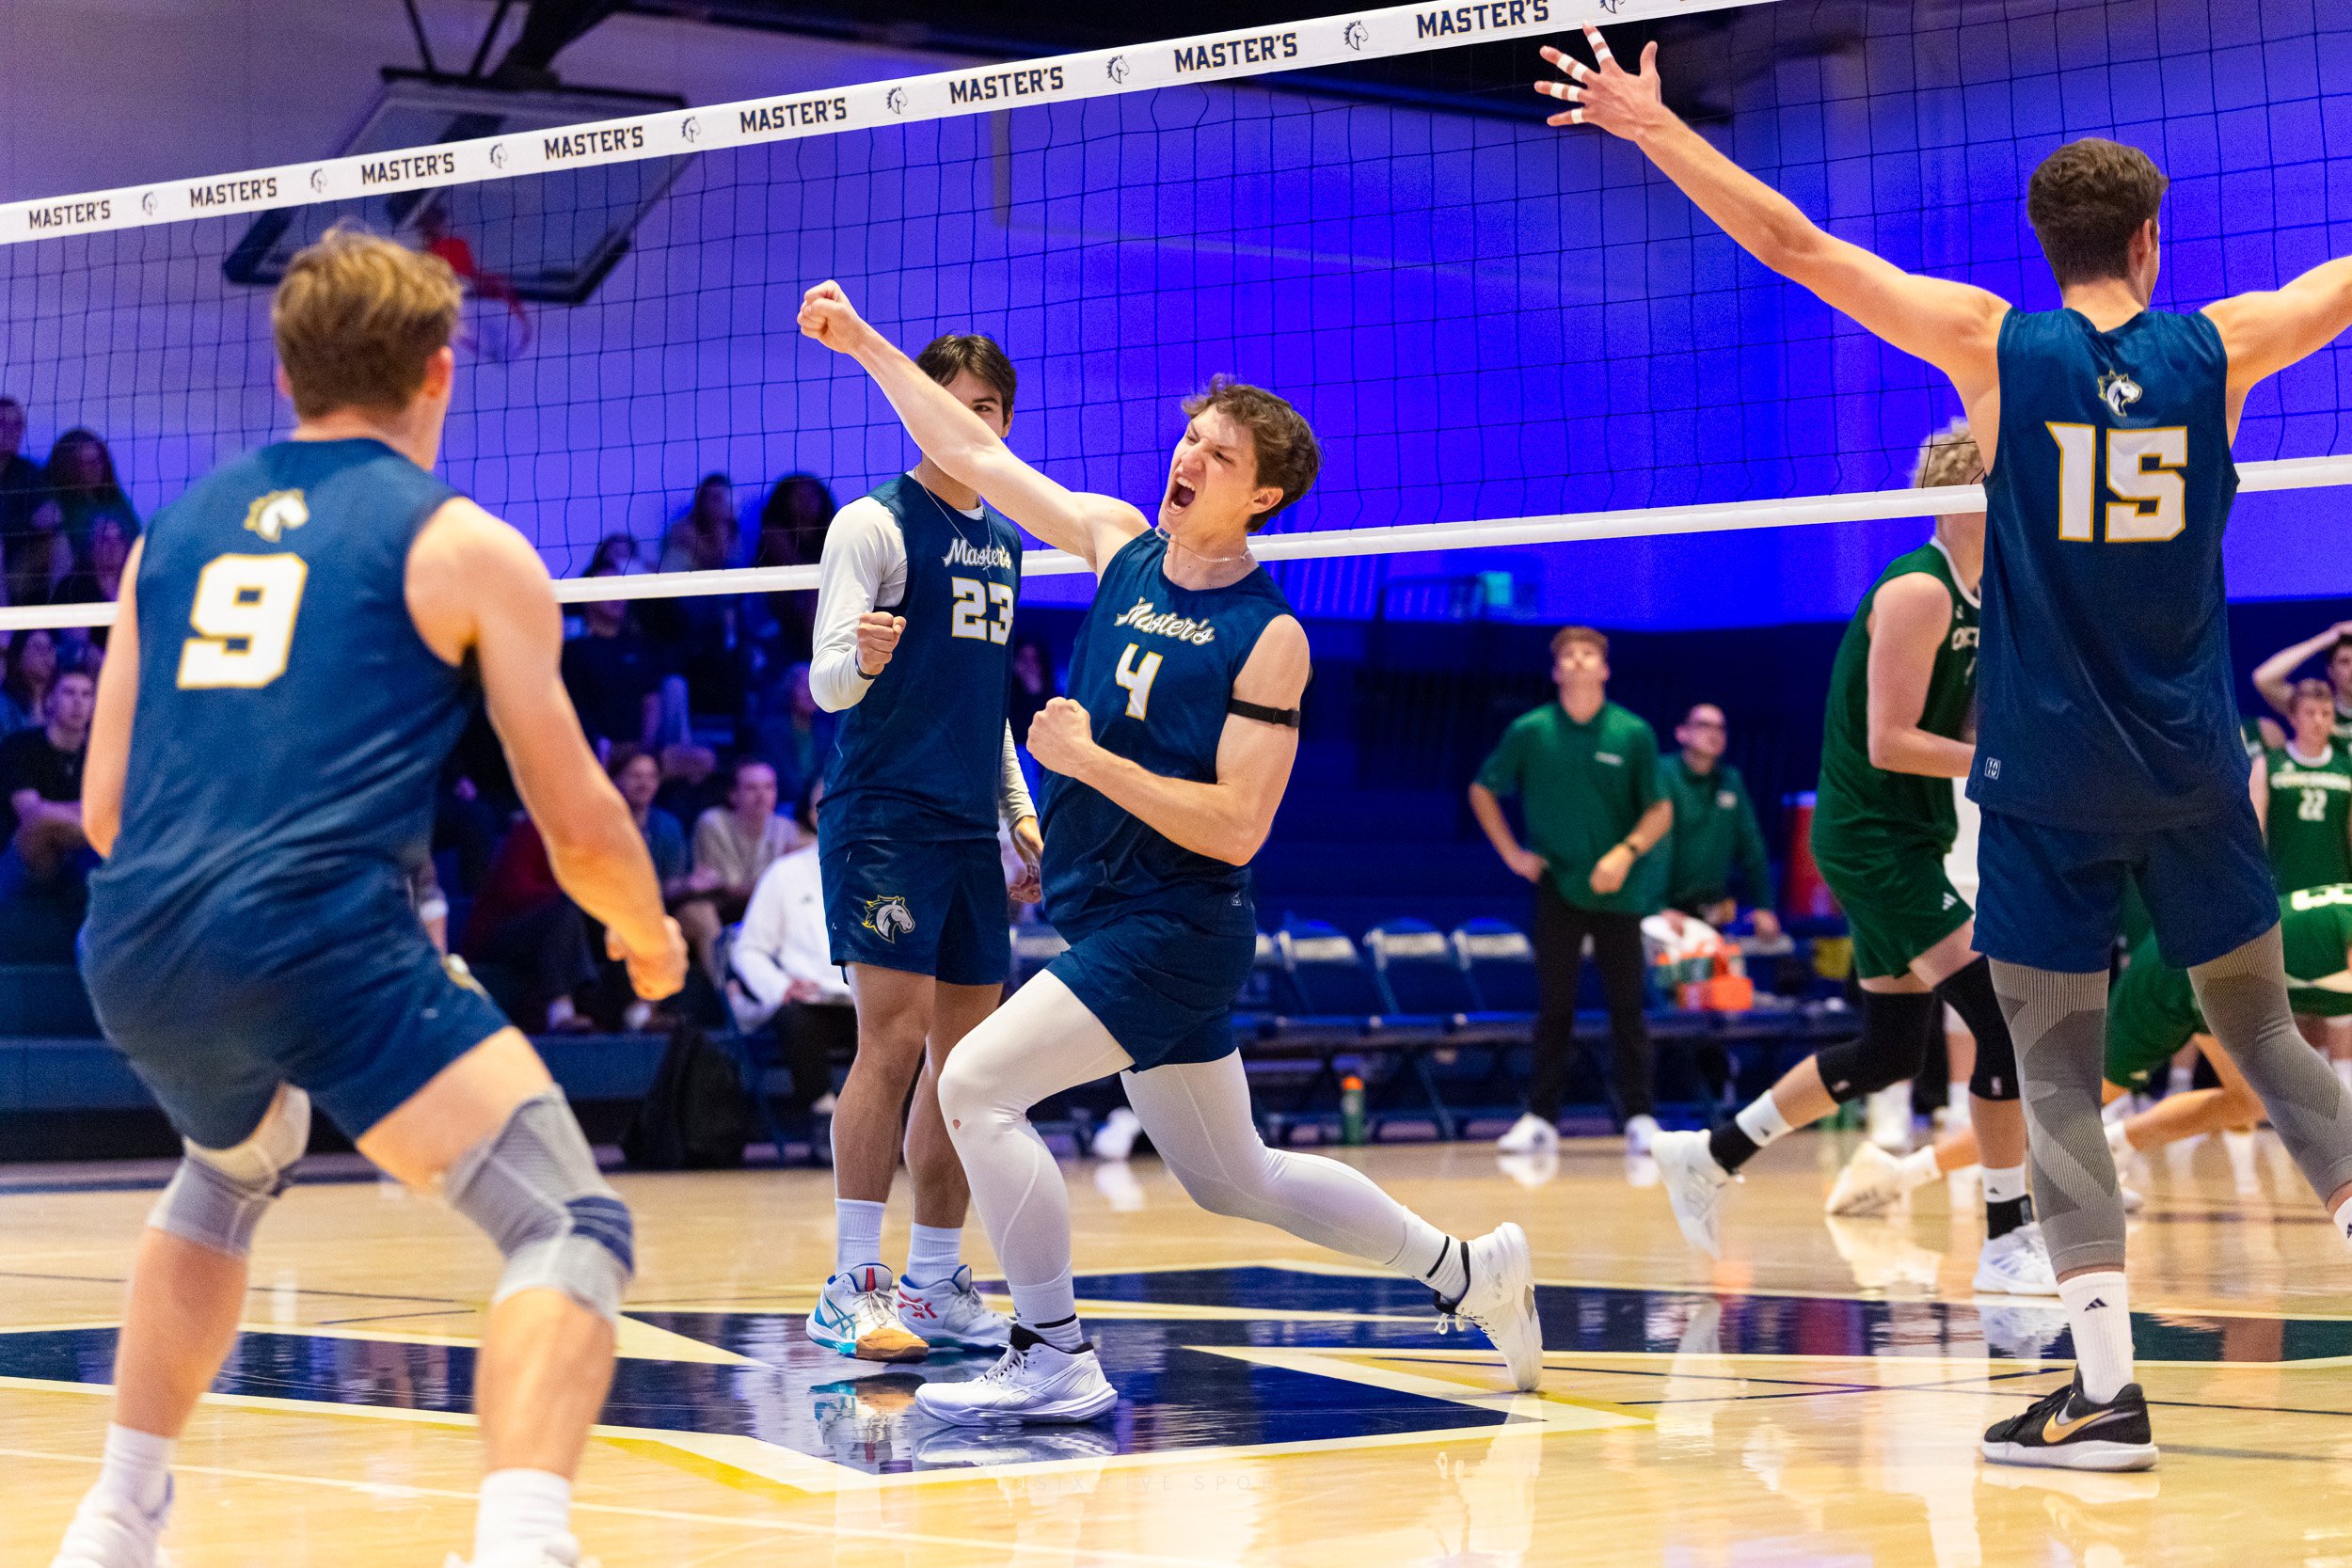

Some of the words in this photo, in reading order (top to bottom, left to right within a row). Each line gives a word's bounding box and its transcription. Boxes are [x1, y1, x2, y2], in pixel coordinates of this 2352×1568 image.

[29, 200, 110, 229] MASTER'S
[190, 178, 277, 208] MASTER'S
[361, 152, 454, 184] MASTER'S
[544, 126, 644, 160] MASTER'S
[740, 98, 847, 133] MASTER'S
[949, 67, 1064, 103] MASTER'S
[1174, 33, 1297, 73] MASTER'S
[1417, 0, 1549, 40] MASTER'S
[2044, 421, 2187, 543] 15
[942, 538, 1011, 569] Master's
[176, 552, 309, 689] 9
[951, 577, 1014, 646] 23
[1114, 596, 1215, 645] Master's
[1115, 643, 1163, 721] 4
